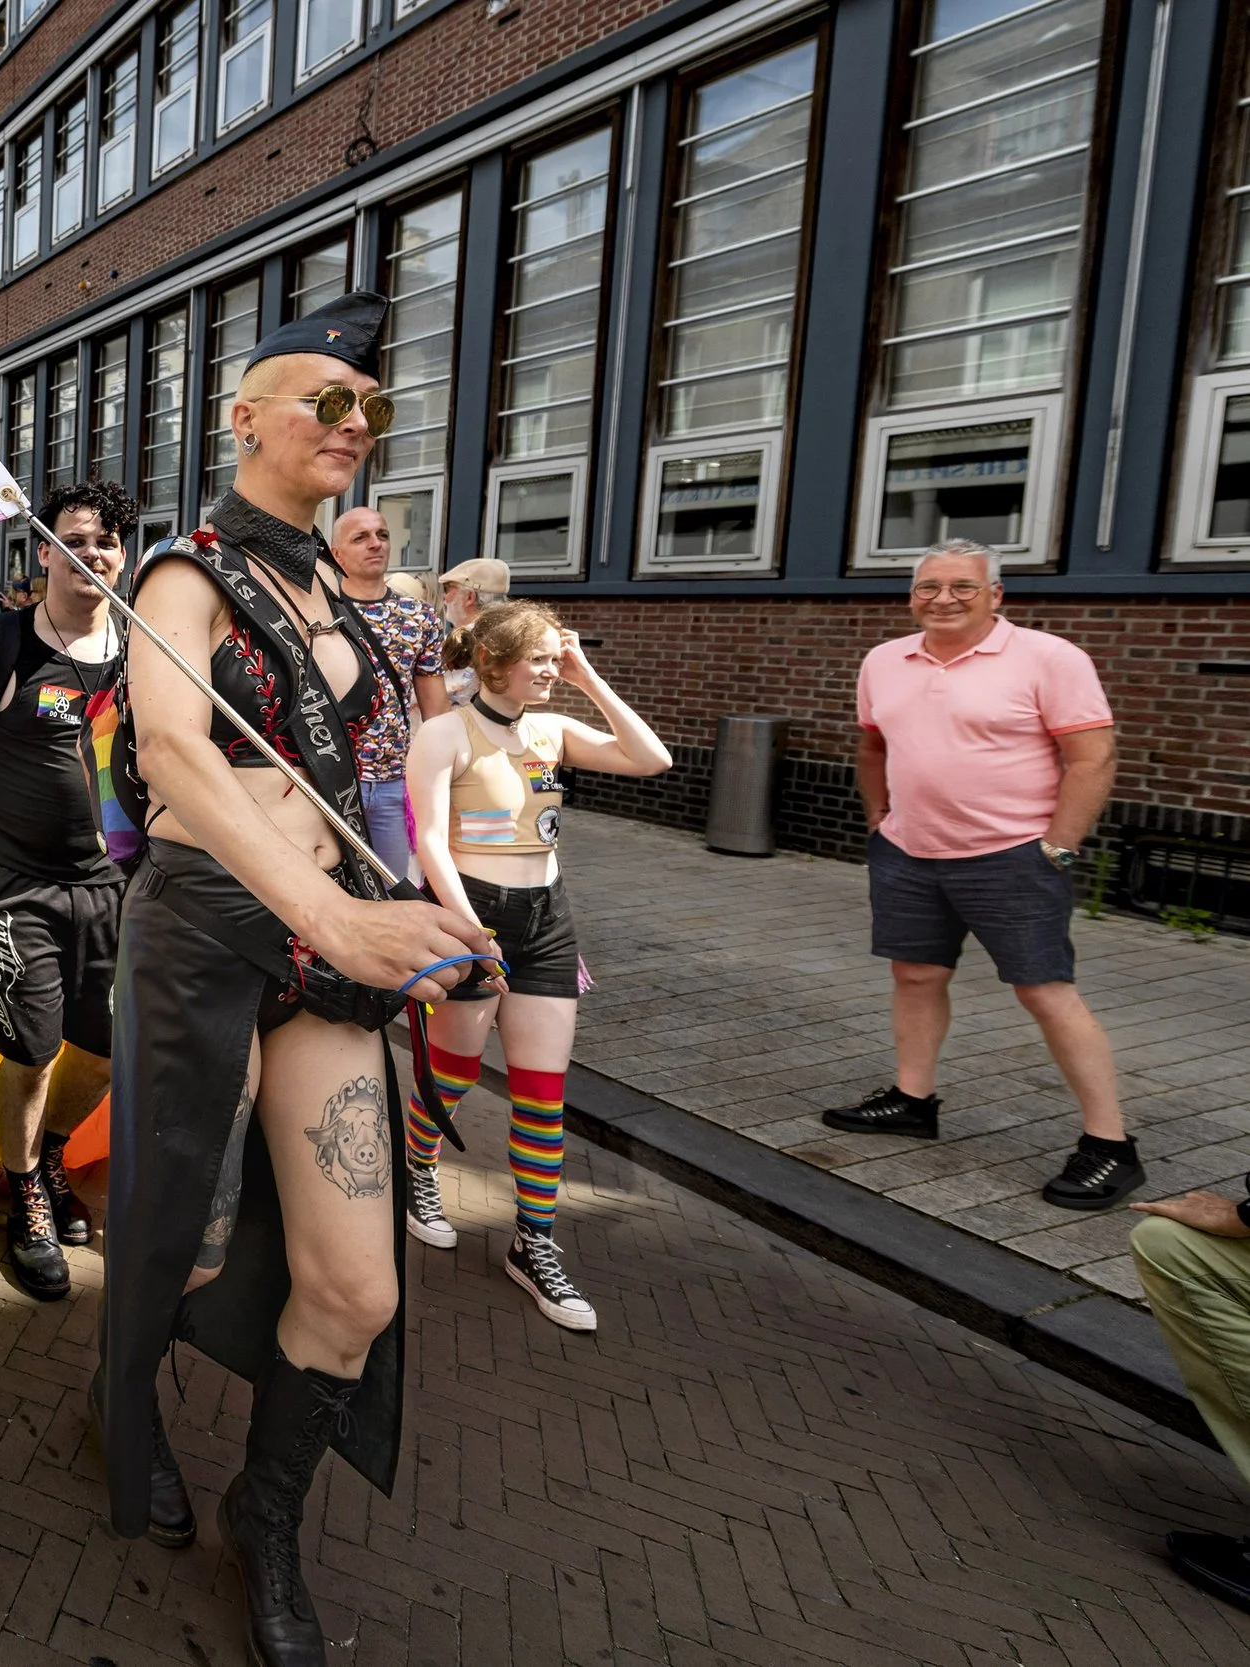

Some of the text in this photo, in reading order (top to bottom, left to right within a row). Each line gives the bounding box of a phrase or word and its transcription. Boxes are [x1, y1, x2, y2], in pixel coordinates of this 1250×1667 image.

[201, 552, 257, 609] Ms.
[42, 687, 67, 698] BE GAY
[49, 710, 58, 718] DO
